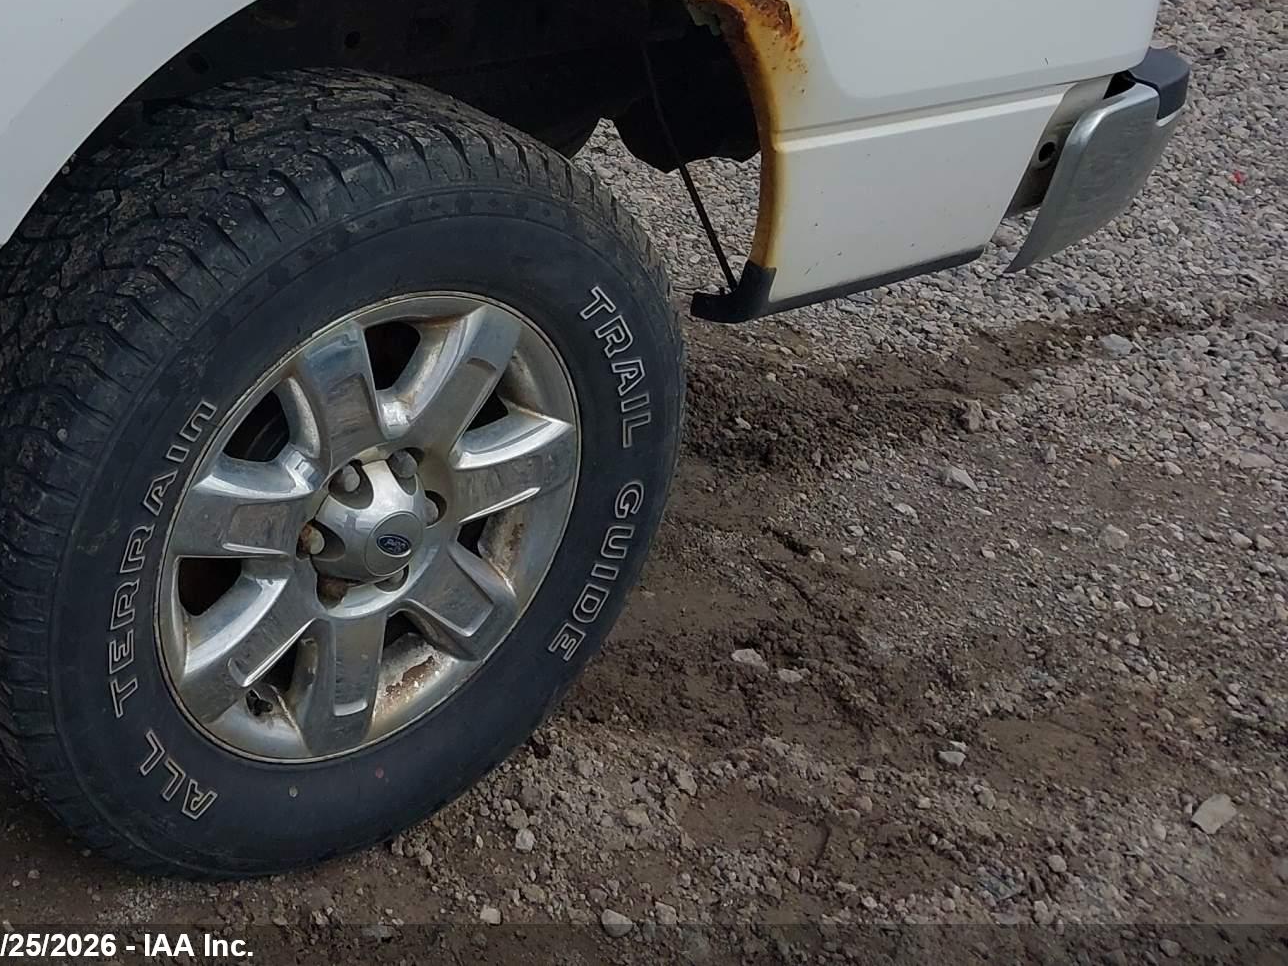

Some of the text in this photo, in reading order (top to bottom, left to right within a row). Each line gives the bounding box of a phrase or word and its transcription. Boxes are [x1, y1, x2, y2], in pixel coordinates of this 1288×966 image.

[548, 286, 654, 662] TRAIL GUIDE
[138, 730, 220, 820] ALL
